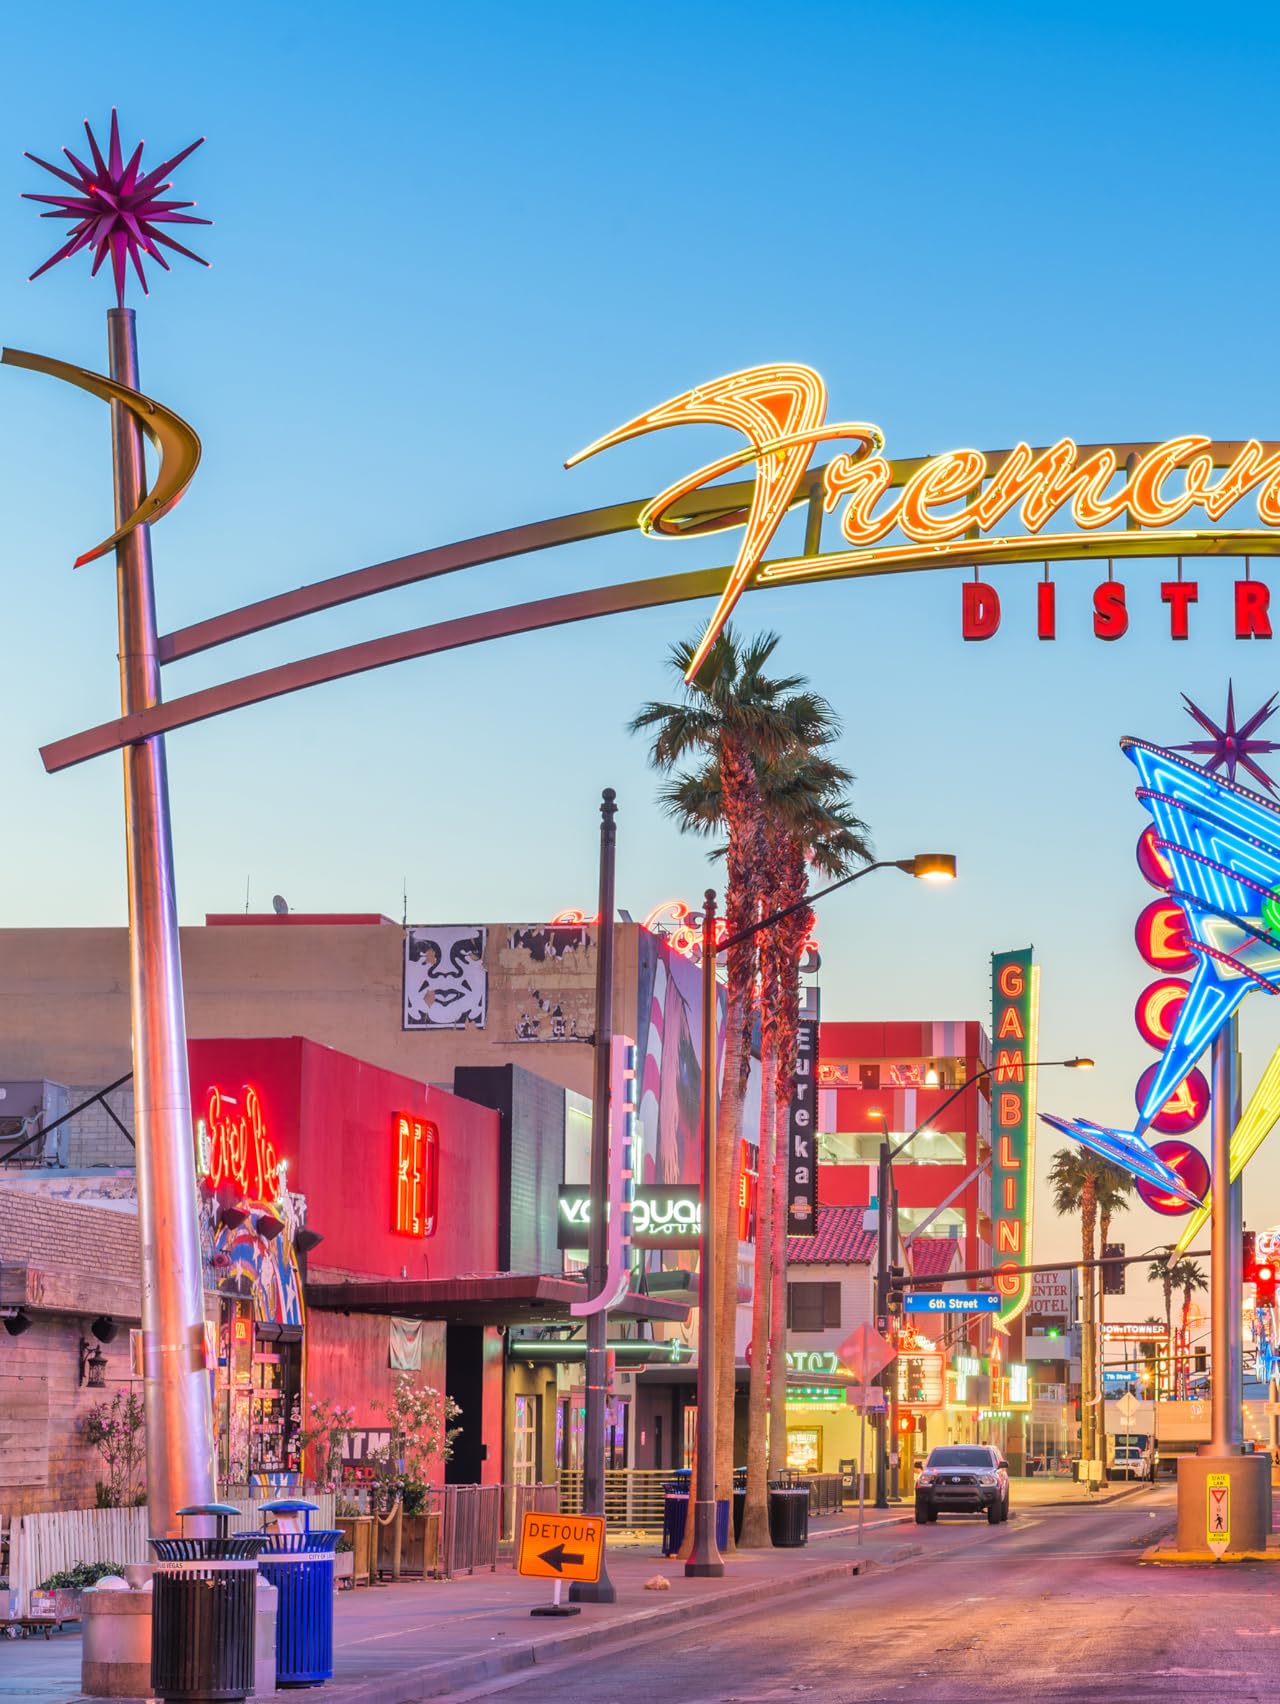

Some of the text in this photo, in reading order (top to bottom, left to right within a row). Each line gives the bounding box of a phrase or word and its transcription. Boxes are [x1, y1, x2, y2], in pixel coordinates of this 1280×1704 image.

[995, 963, 1026, 1297] GAMBLING
[560, 1199, 701, 1232] vagua
[649, 1223, 701, 1234] LOUN
[1034, 1273, 1059, 1284] CITY
[1032, 1285, 1068, 1296] ENTER
[929, 1299, 946, 1309] 6th
[949, 1299, 978, 1309] Street
[529, 1523, 596, 1542] DETOUR
